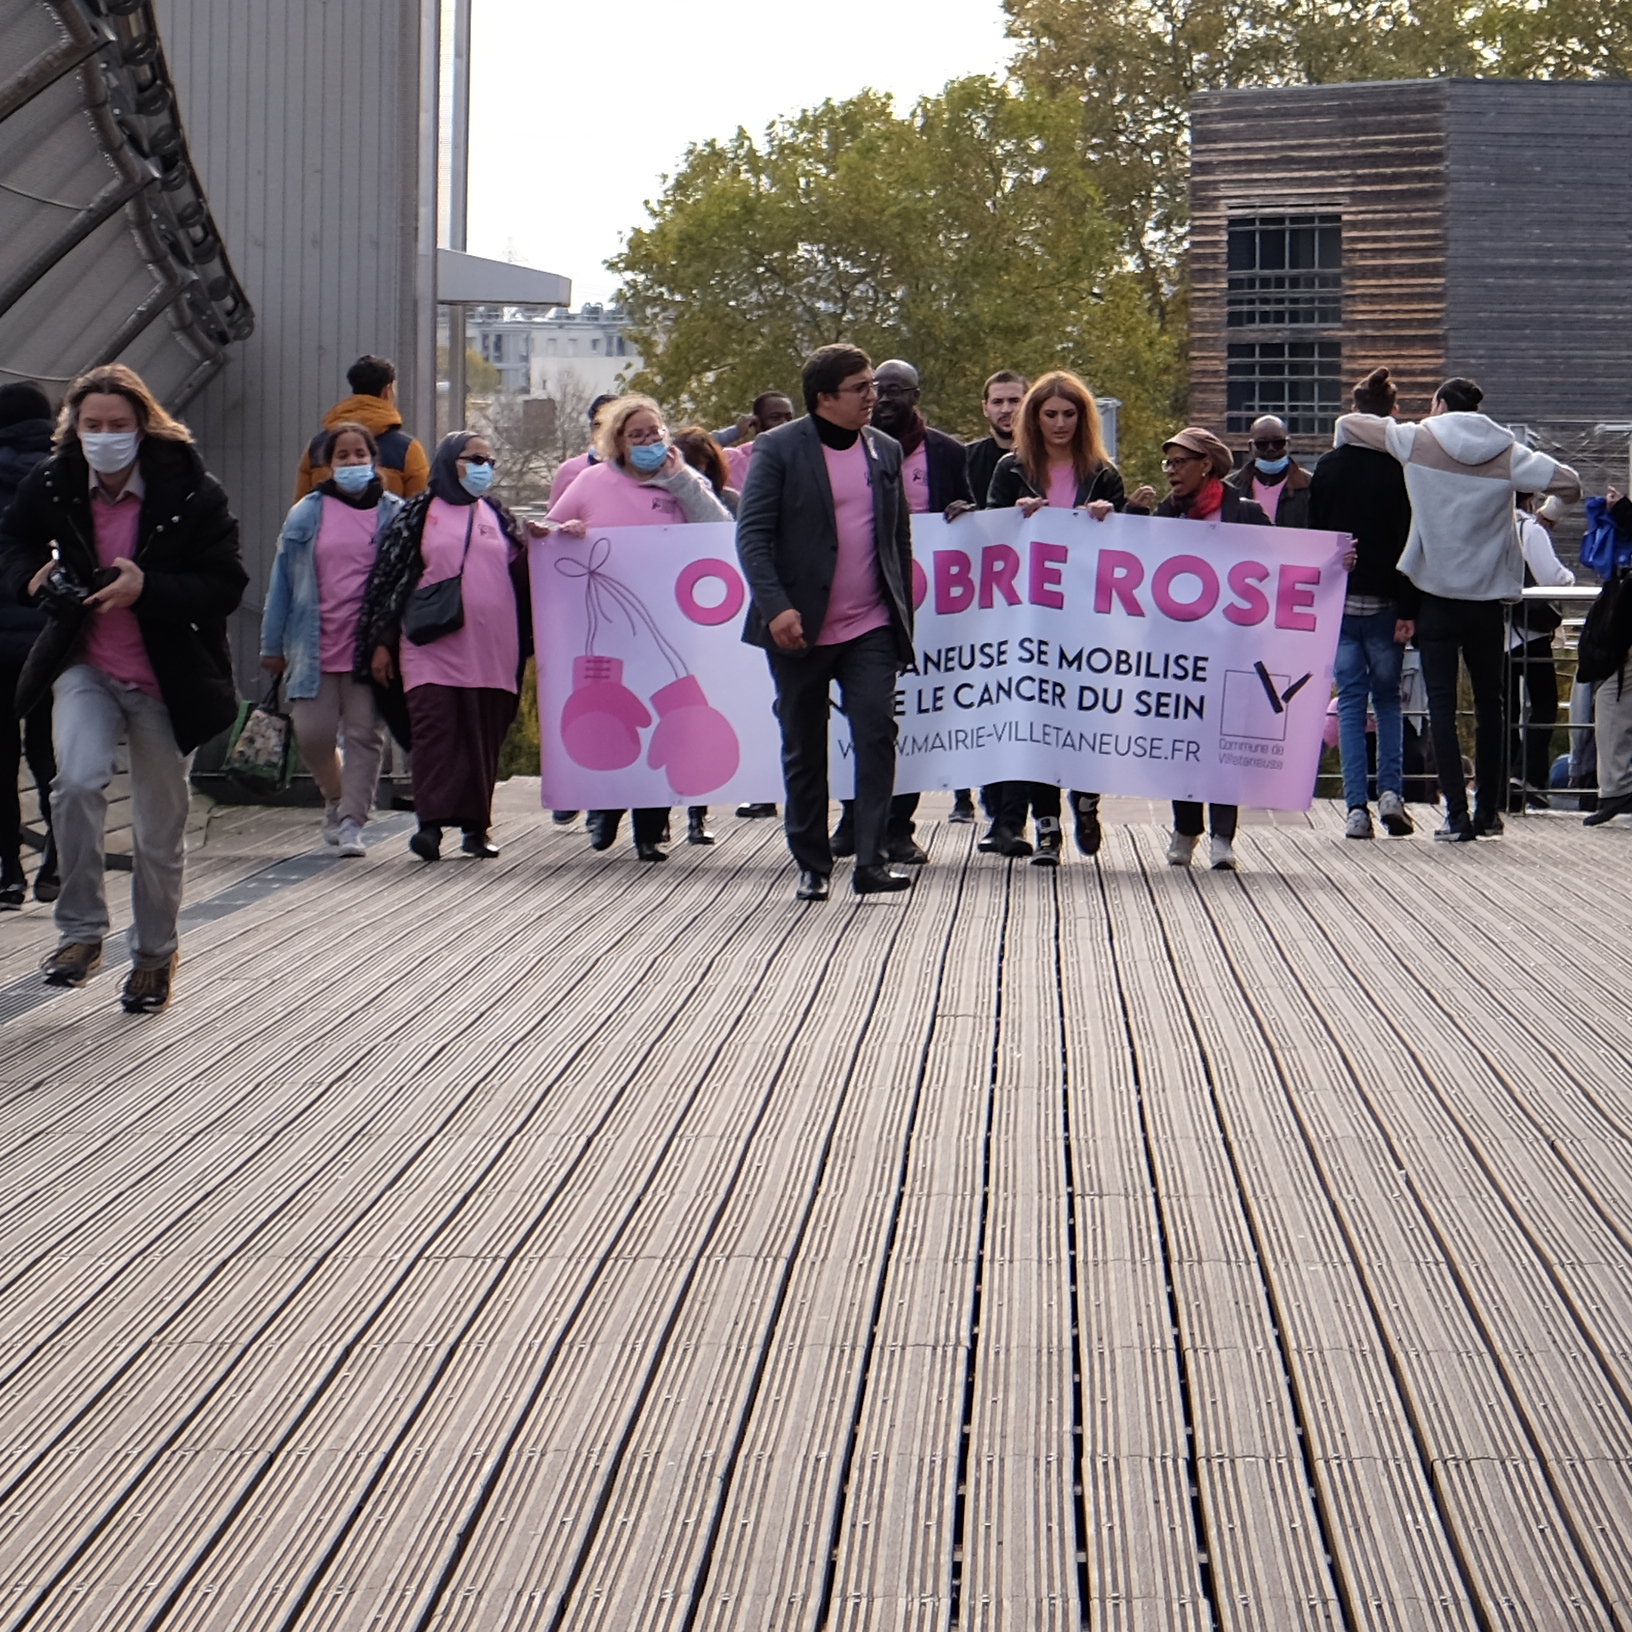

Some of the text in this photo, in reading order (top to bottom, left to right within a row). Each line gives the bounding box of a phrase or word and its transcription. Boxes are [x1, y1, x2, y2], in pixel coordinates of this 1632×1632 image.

[674, 541, 1321, 633] OBRE ROSE
[1017, 636, 1050, 667] SE
[1057, 643, 1209, 683] MOBILISE
[916, 685, 945, 715] LE
[953, 675, 1067, 710] CANCER
[1077, 684, 1123, 715] DU
[1133, 689, 1206, 721] SEIN
